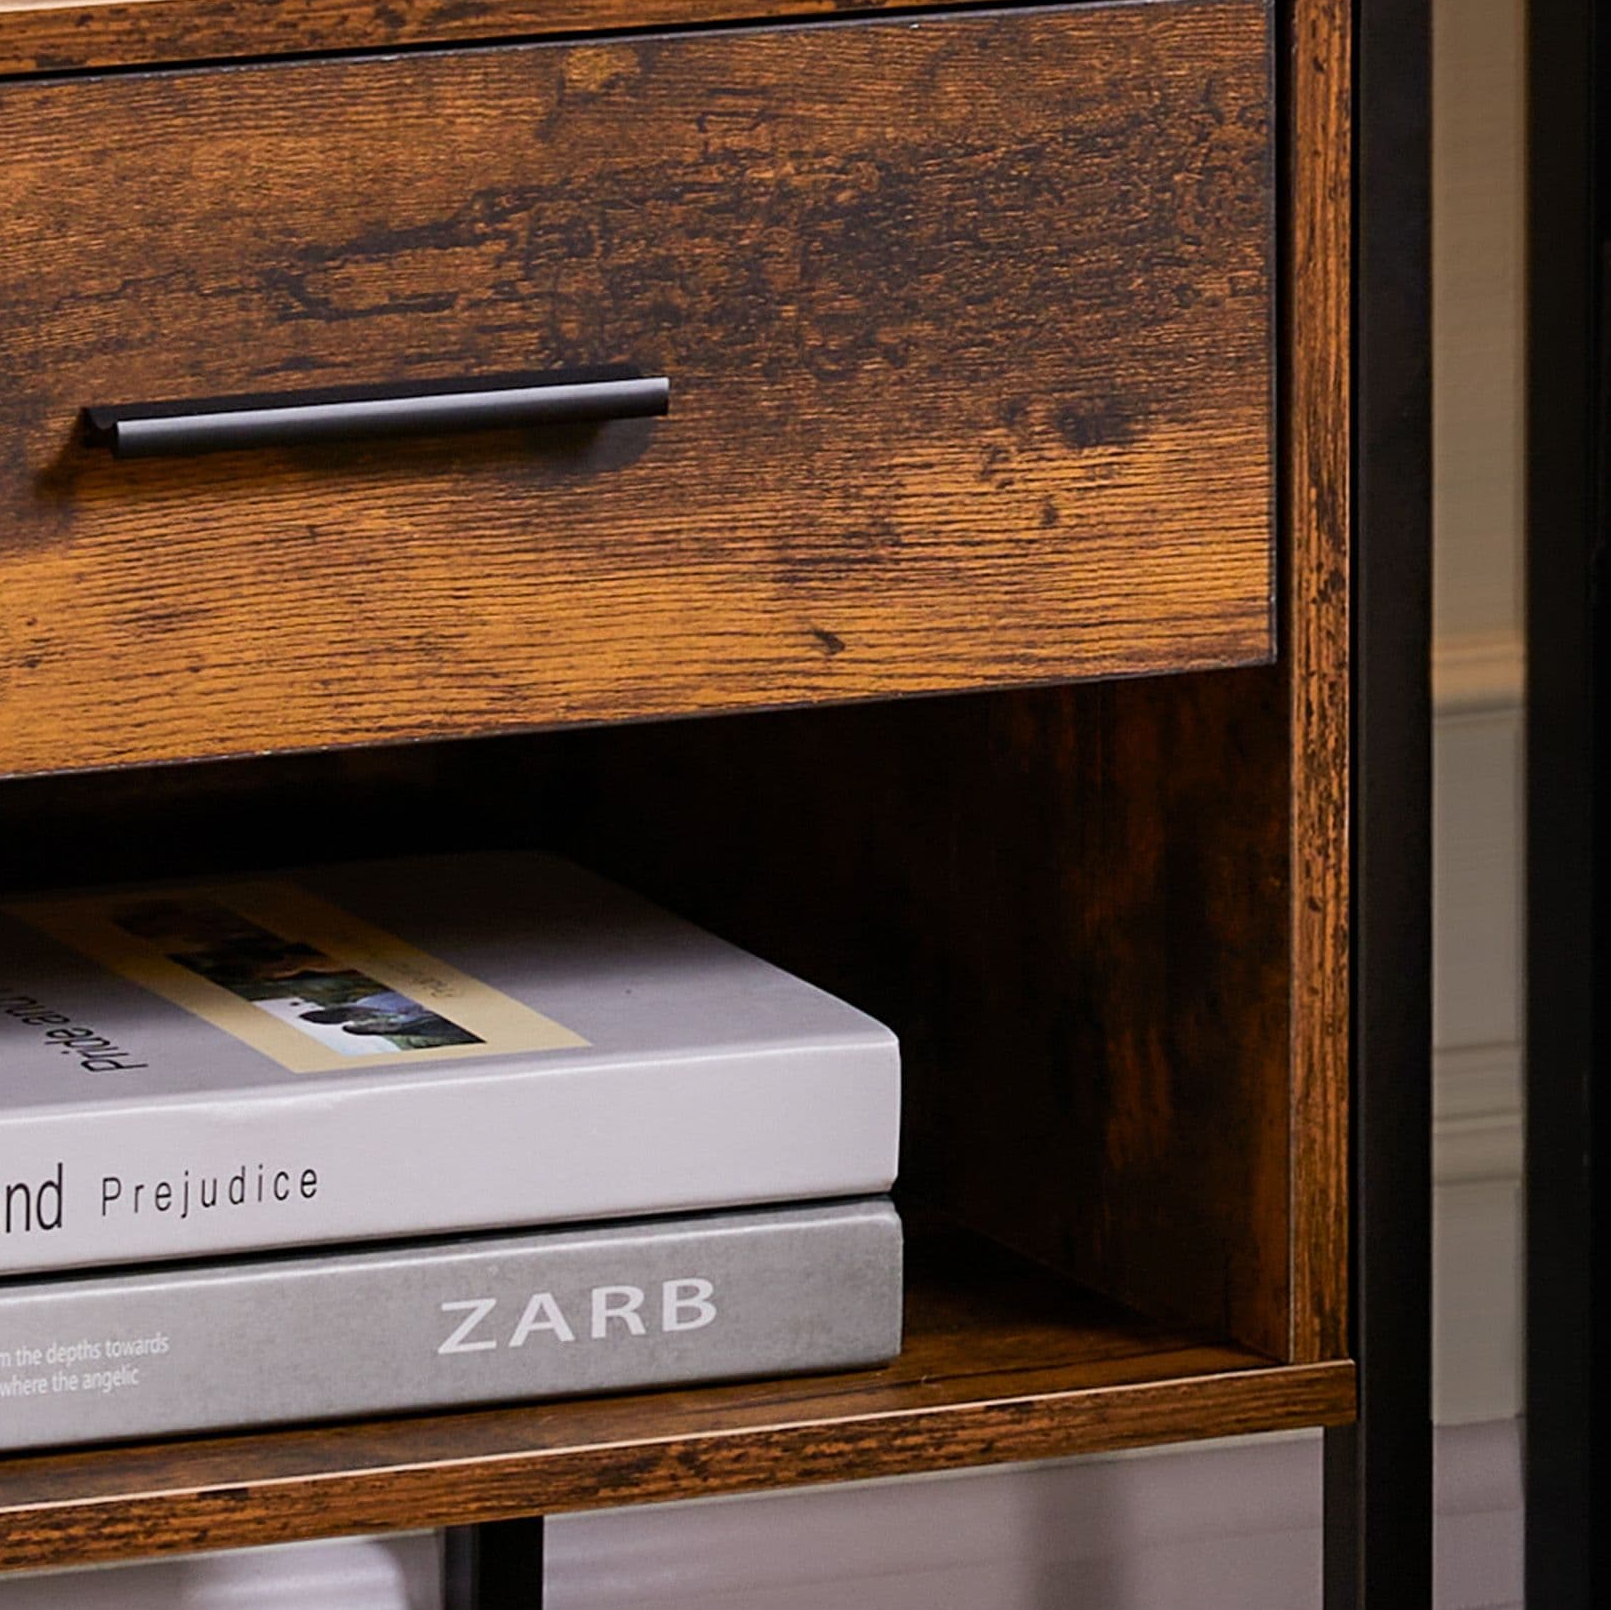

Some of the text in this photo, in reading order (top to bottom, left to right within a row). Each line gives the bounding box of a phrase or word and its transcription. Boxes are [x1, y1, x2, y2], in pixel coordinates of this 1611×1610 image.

[101, 1163, 319, 1219] Prejudice
[438, 1278, 717, 1355] ZARB
[16, 1345, 42, 1366] the
[46, 1341, 101, 1368] depths
[105, 1332, 169, 1358] towards
[52, 1370, 79, 1392] the
